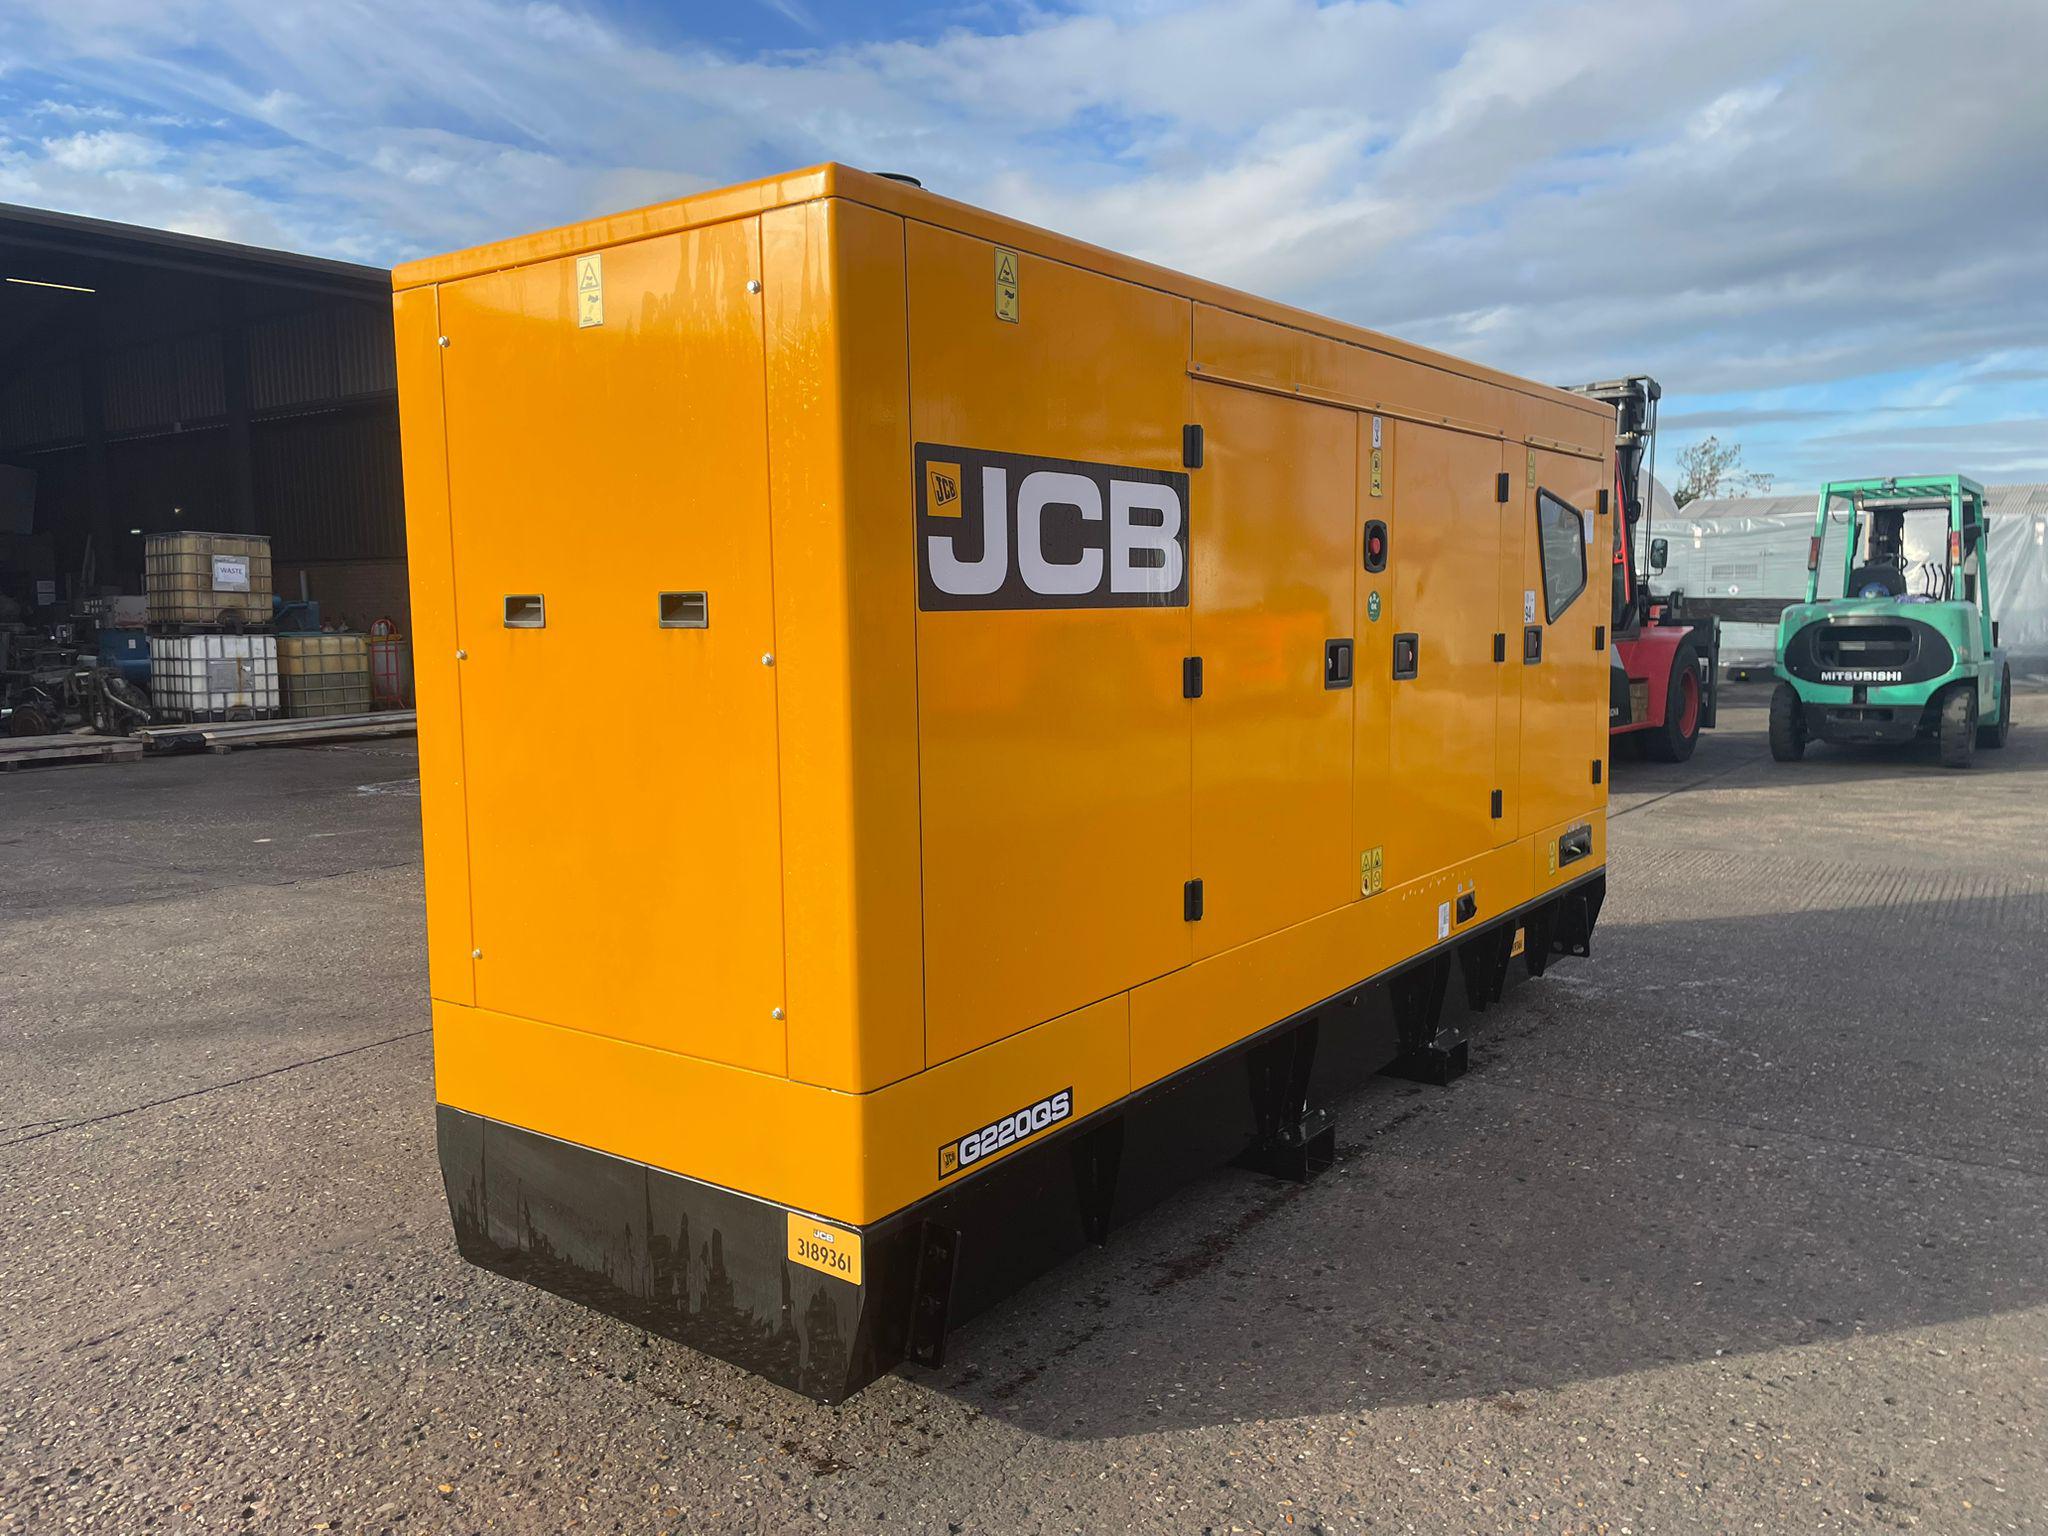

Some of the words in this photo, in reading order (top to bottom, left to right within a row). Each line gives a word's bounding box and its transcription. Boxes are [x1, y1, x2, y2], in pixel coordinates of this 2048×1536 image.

[935, 475, 957, 502] JCB
[928, 466, 1183, 595] JCB
[220, 567, 242, 575] WASTE
[1821, 671, 1902, 682] MITSUBISHI
[959, 1091, 1070, 1166] G220QS
[814, 1229, 834, 1243] JCB
[798, 1238, 851, 1273] 3189361
